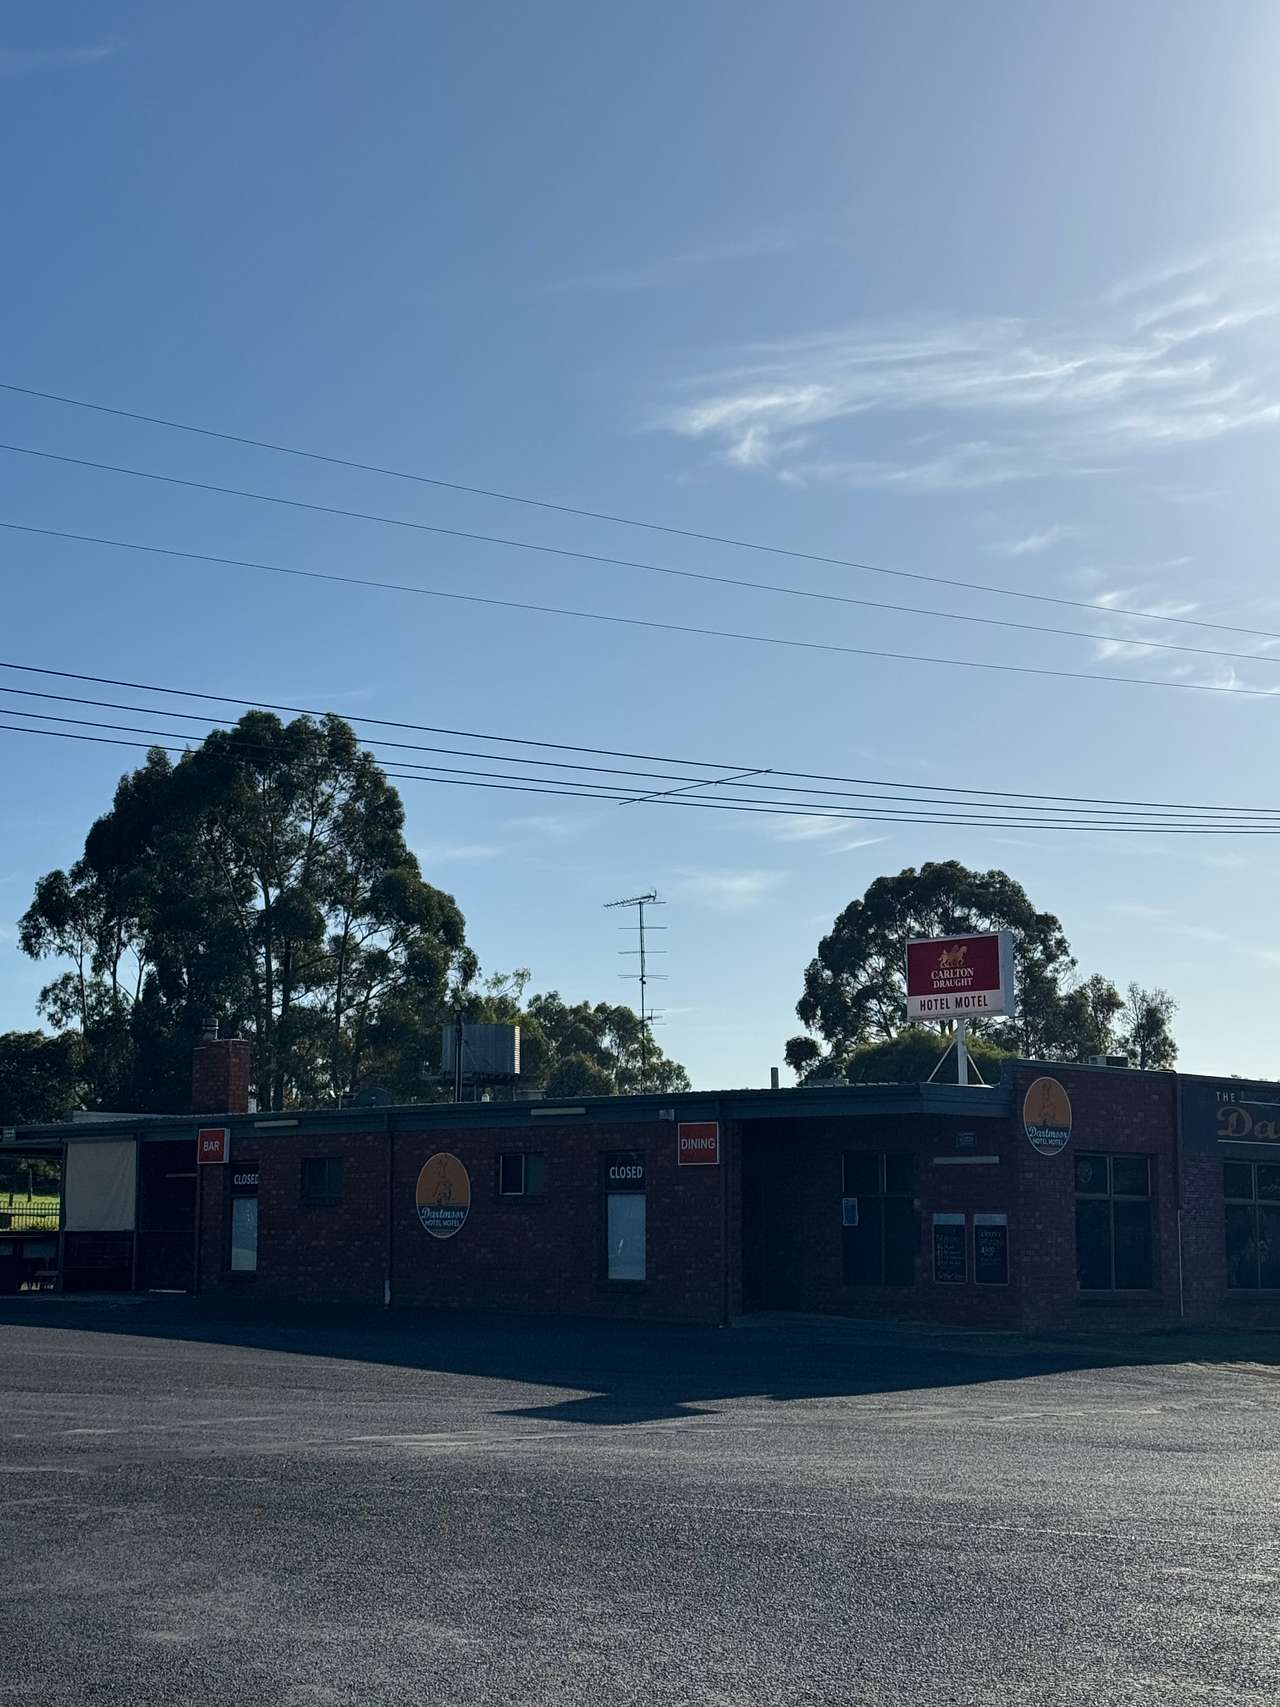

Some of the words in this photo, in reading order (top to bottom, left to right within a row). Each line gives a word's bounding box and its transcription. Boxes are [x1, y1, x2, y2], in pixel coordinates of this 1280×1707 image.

[931, 967, 975, 980] CARLTON
[933, 978, 974, 989] DRAUGHT
[920, 997, 951, 1011] HOTEL
[955, 995, 988, 1009] MOTEL
[1216, 1091, 1236, 1103] THE
[203, 1140, 220, 1152] BAR
[680, 1137, 716, 1150] DINING
[609, 1165, 643, 1179] CLOSED
